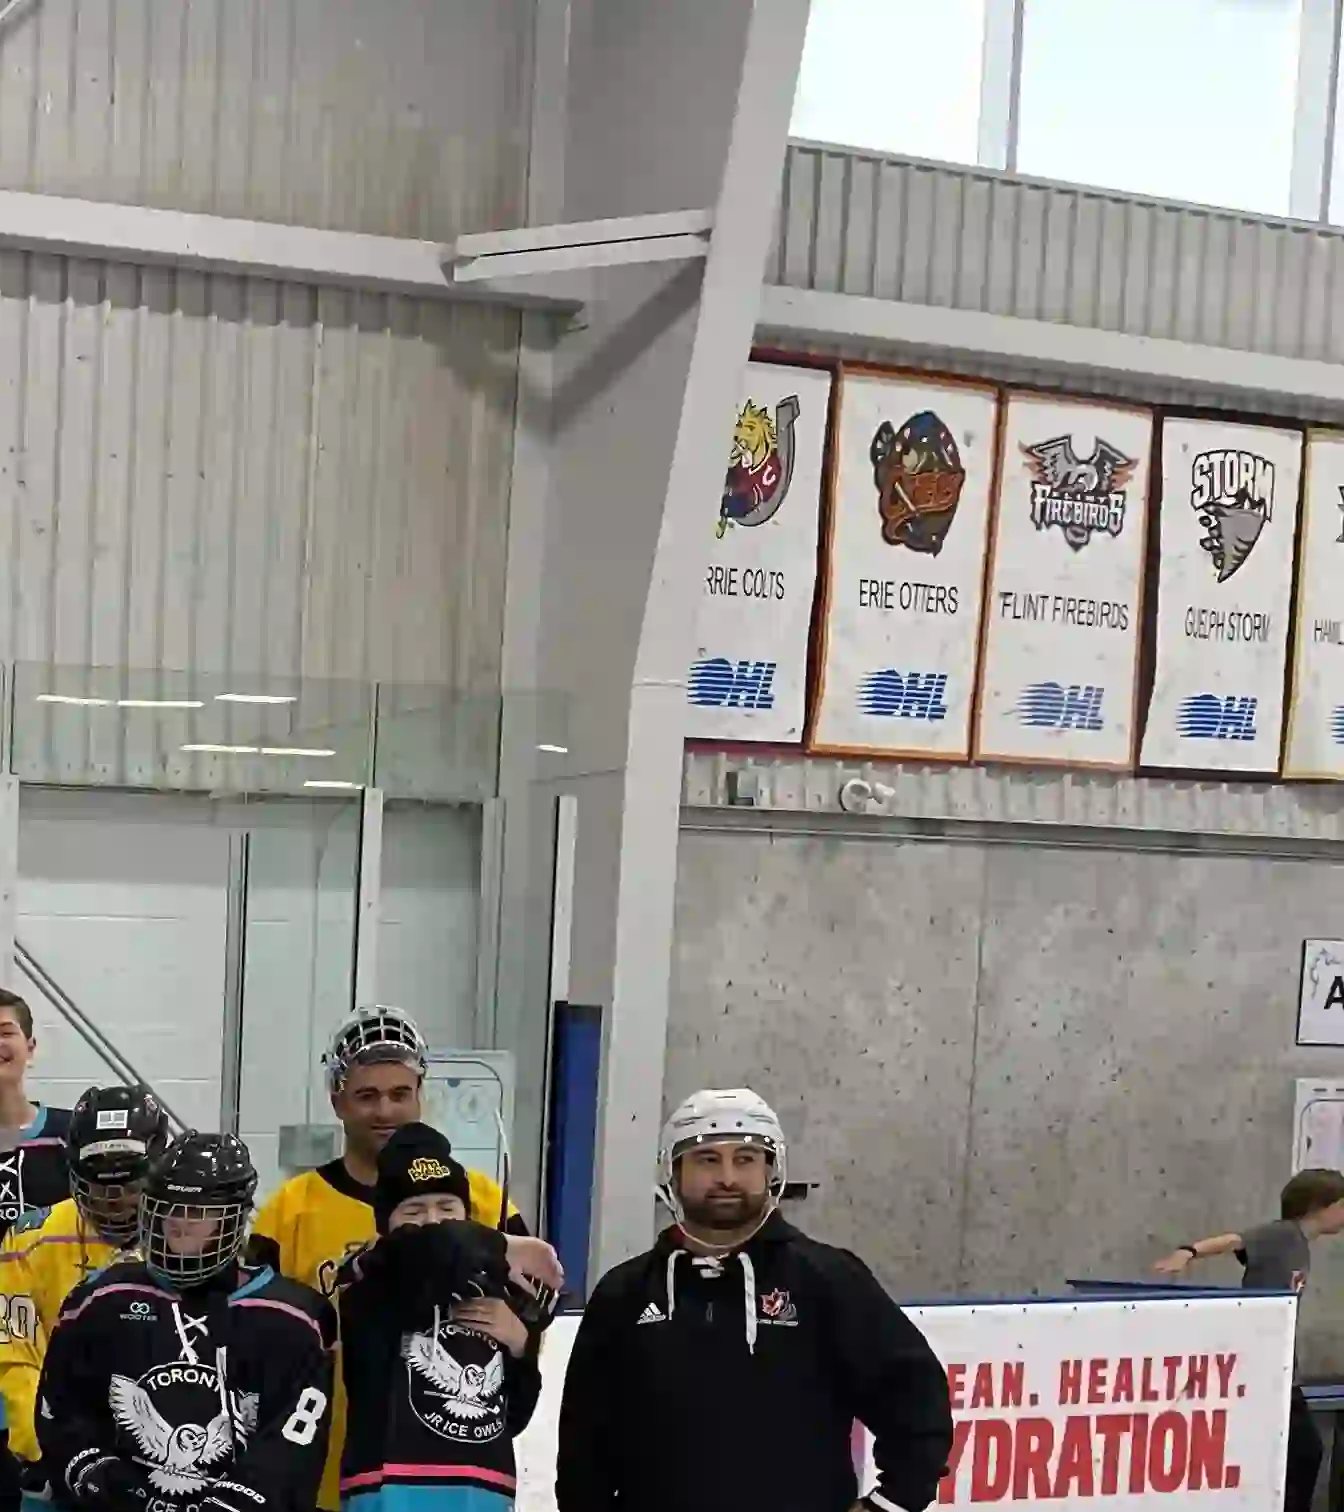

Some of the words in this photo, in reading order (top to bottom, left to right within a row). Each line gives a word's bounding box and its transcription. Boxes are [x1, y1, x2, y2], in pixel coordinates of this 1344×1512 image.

[1030, 481, 1126, 536] FIREBIRDS
[1191, 449, 1275, 522] STORM
[706, 566, 738, 597] RRIE
[743, 567, 785, 600] COLTS
[859, 578, 895, 609] ERIE
[899, 581, 959, 614] OTTERS
[998, 591, 1050, 621] FLINT
[1052, 597, 1129, 631] FIREBIRDS
[1185, 606, 1225, 642] GUELPH
[1227, 611, 1271, 643] STORM
[686, 657, 777, 709] OHL
[855, 667, 949, 720] OHL
[1175, 693, 1259, 741] OHL
[145, 1367, 221, 1394] TORON
[948, 1361, 1040, 1410] EAN.
[1058, 1353, 1246, 1406] HEALTHY.
[281, 1386, 328, 1447] 8
[423, 1410, 443, 1429] JR
[442, 1418, 470, 1438] ICE
[937, 1409, 1241, 1505] YDRATION.
